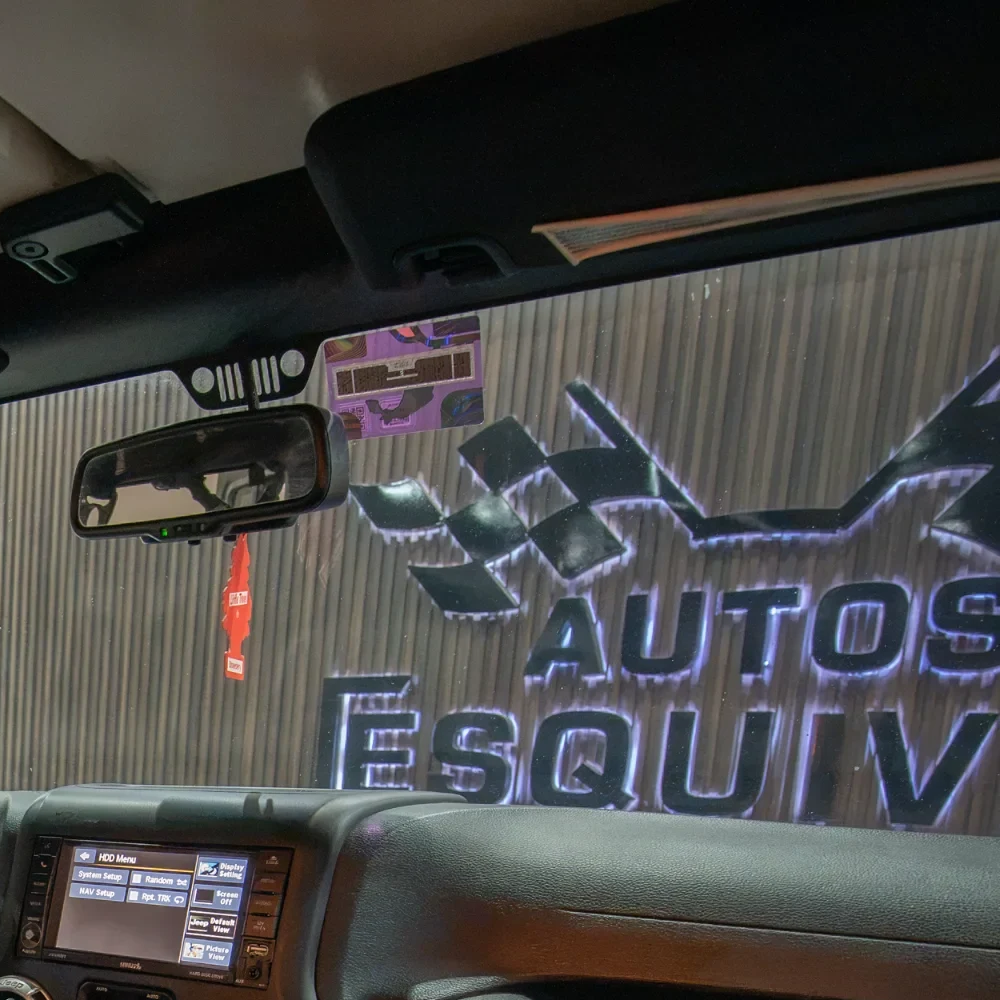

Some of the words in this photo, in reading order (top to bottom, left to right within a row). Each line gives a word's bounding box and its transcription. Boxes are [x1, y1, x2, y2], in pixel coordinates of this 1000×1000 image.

[524, 575, 1000, 677] AUTOS
[98, 853, 115, 862] HDD
[115, 854, 137, 864] Menu
[220, 863, 245, 872] Display
[78, 870, 102, 879] System
[102, 872, 123, 882] Setup
[219, 870, 243, 879] Setting
[145, 876, 174, 885] Random
[79, 887, 95, 896] NAV
[95, 888, 115, 898] Setup
[216, 890, 239, 898] Screen
[157, 894, 171, 902] TRK
[190, 918, 209, 927] Jeep
[210, 917, 235, 926] Default
[213, 925, 230, 933] View
[206, 944, 230, 953] Picture
[208, 952, 225, 961] View
[0, 980, 24, 989] Jeep
